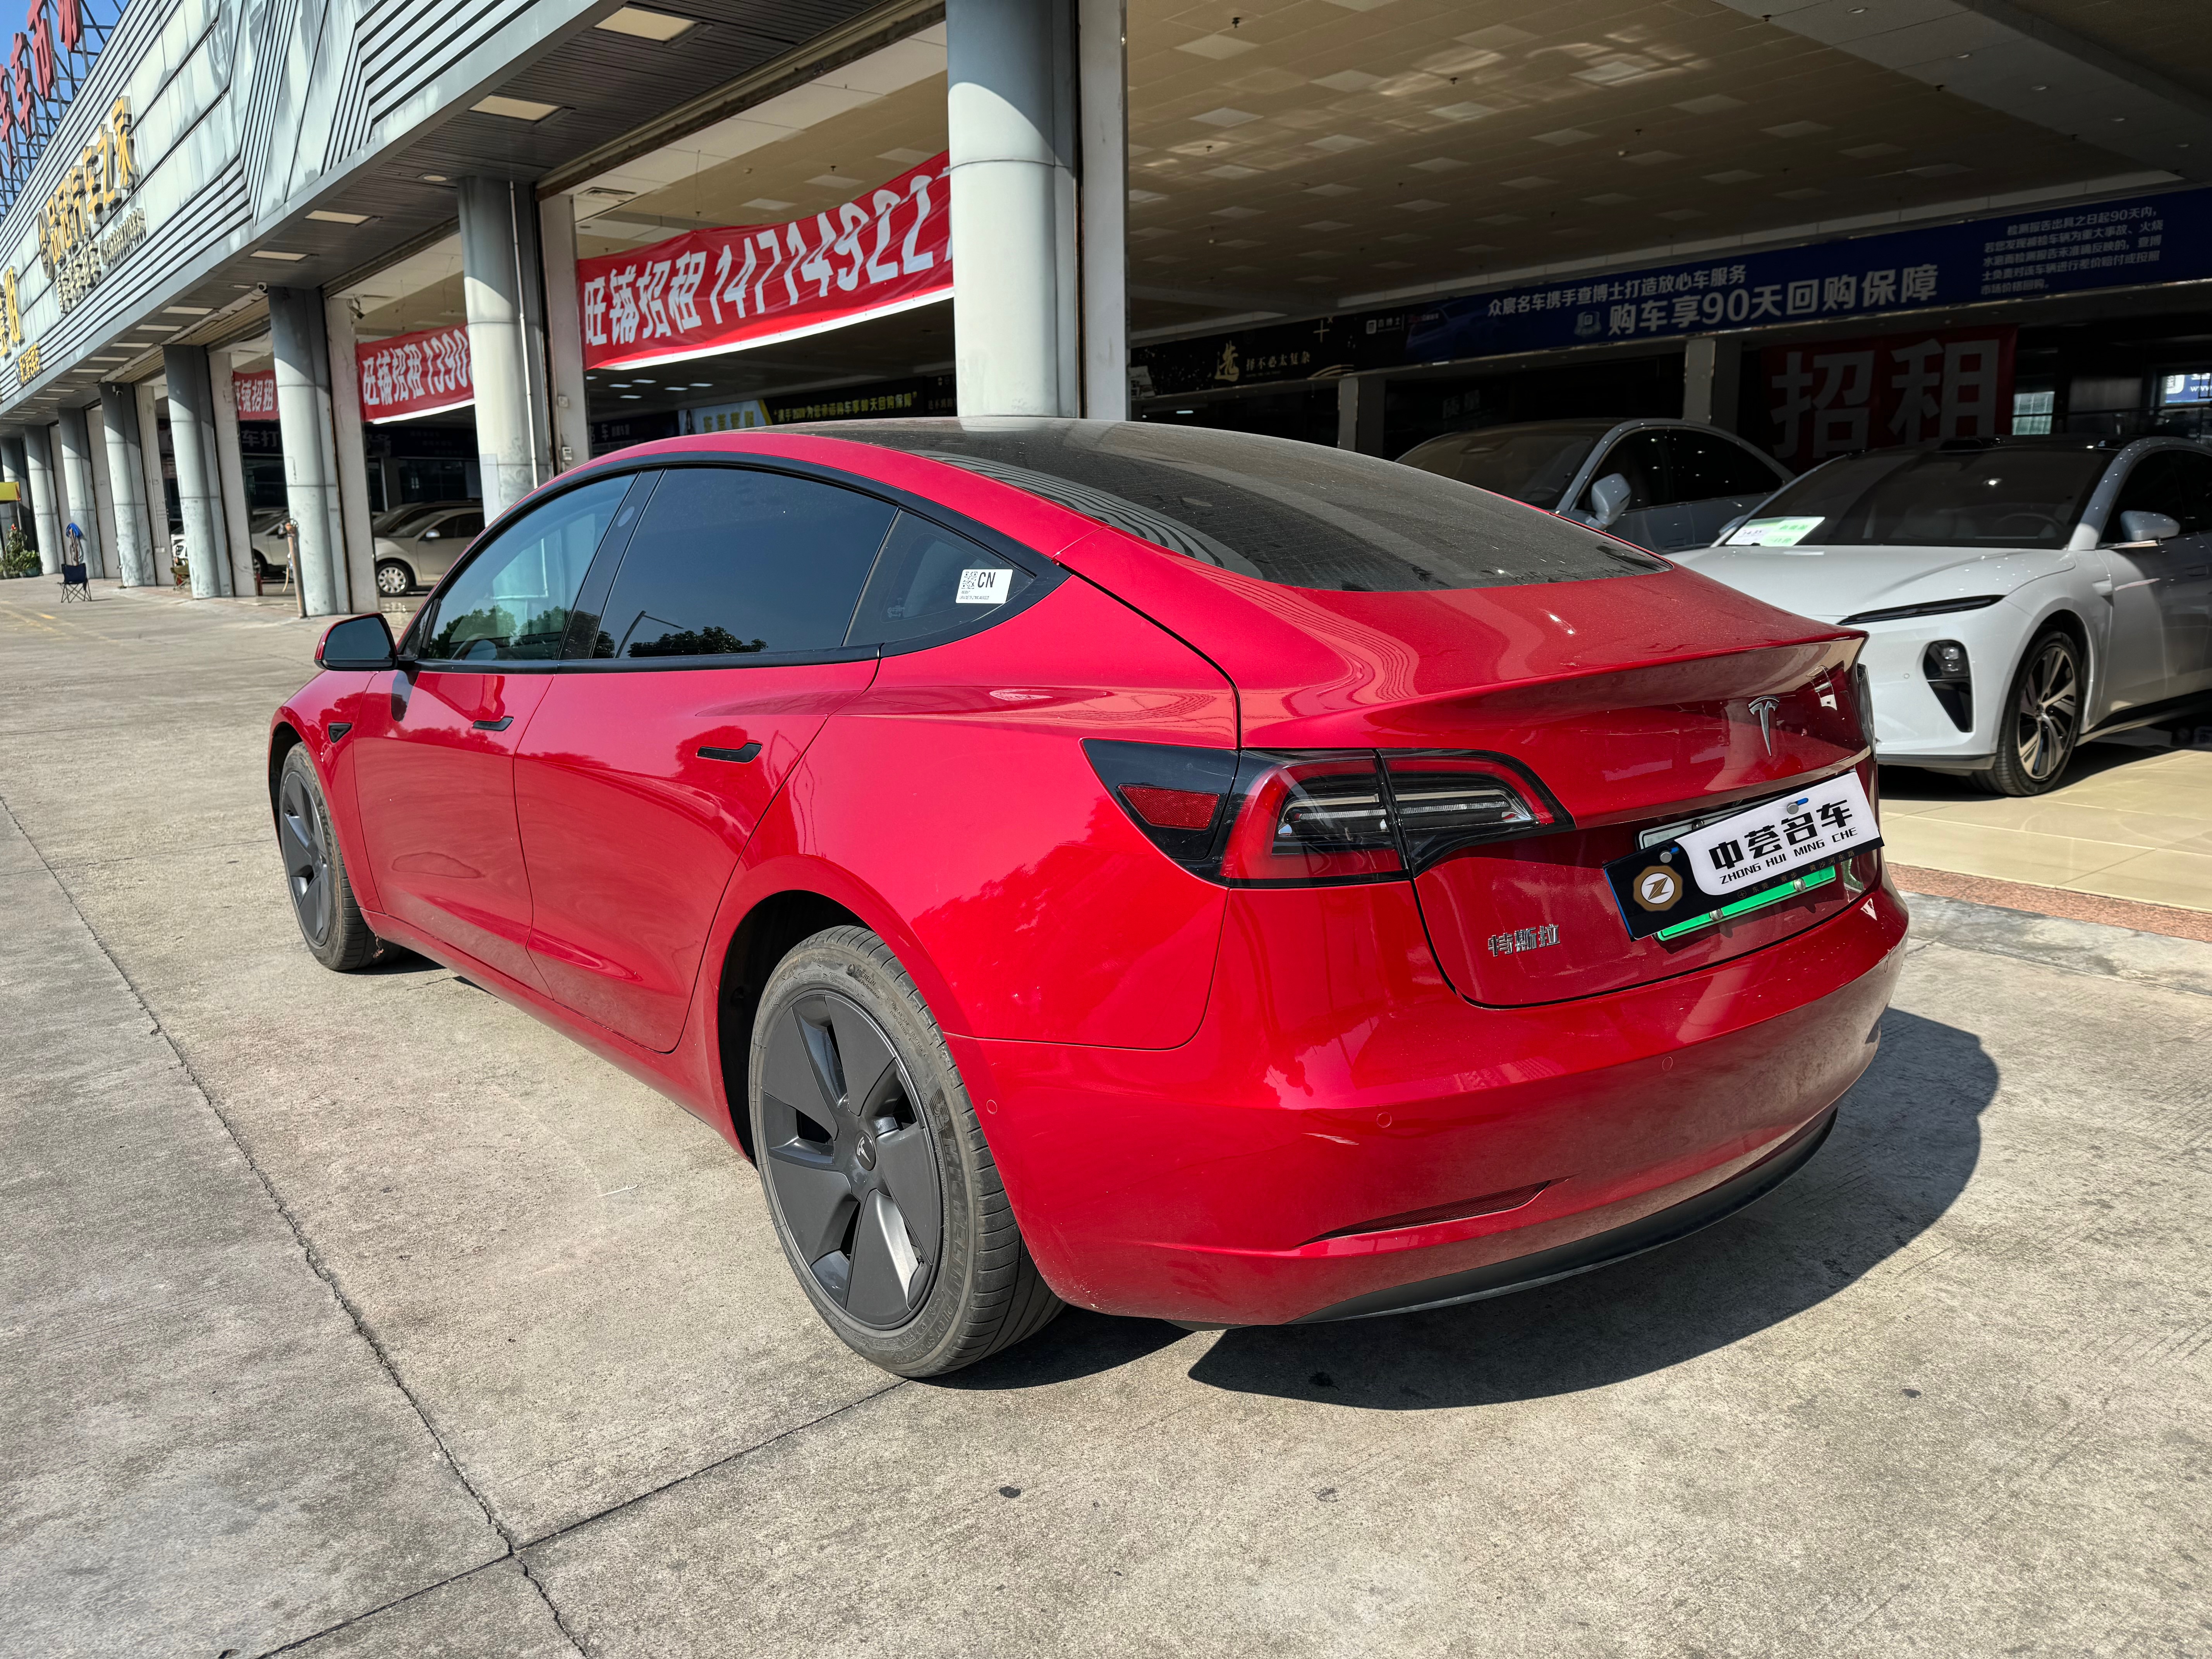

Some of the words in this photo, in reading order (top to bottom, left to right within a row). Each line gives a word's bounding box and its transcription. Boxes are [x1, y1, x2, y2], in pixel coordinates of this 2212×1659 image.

[584, 251, 708, 346] 旺铺招租
[1608, 264, 1939, 336] 购车享90天回购保障
[362, 343, 425, 406] 旺铺招租
[1770, 338, 2001, 459] 招租
[977, 572, 996, 588] CN
[1708, 799, 1853, 870] 中荟名车
[1719, 863, 1762, 884] ZHONG
[1765, 853, 1787, 867] HUI
[1793, 839, 1826, 857] MING
[1831, 827, 1858, 843] CHE
[1488, 923, 1561, 957] 特斯拉
[855, 969, 876, 986] MICHELIN
[943, 1137, 966, 1295] MICHELIN
[912, 1335, 935, 1360] SPORT
[936, 1304, 954, 1338] PILOT
